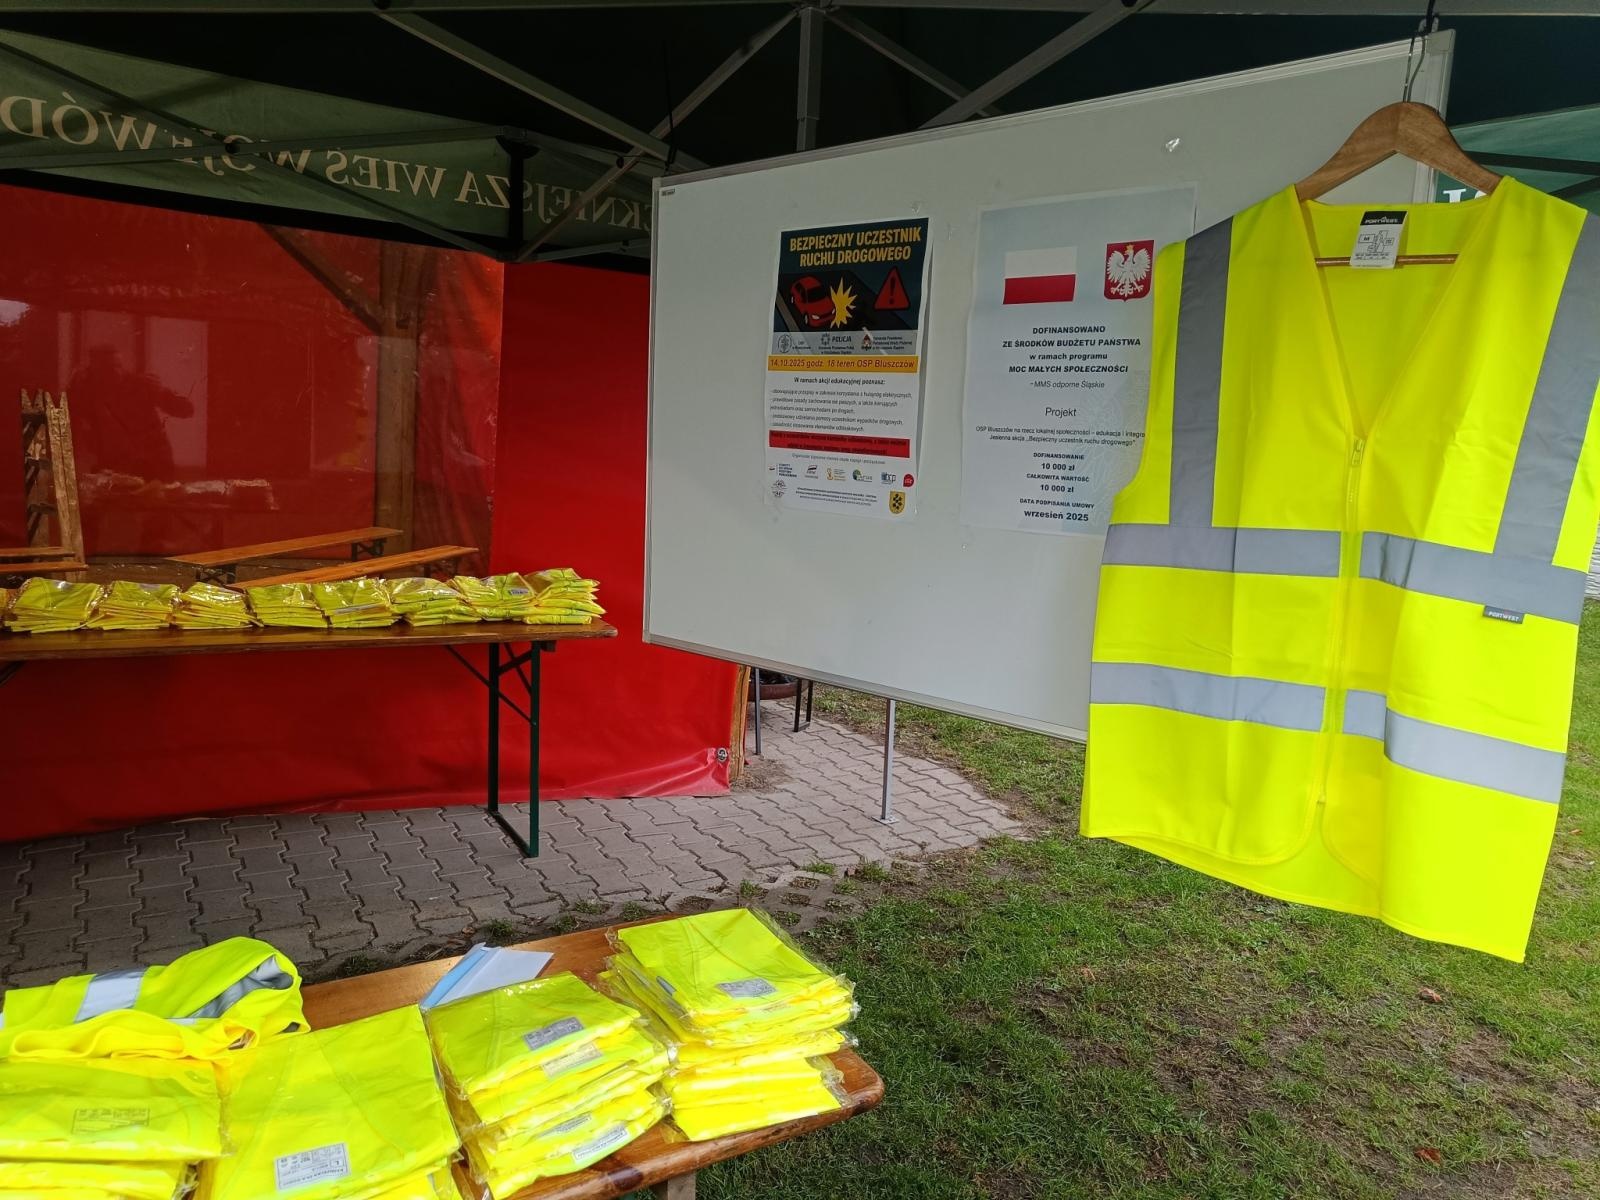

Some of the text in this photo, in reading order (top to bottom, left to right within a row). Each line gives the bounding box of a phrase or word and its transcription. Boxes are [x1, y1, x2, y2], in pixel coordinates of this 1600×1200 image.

[790, 226, 922, 252] BEZPIECZNY UCZESTNIK
[800, 246, 912, 267] RUCHU DROGOWEGO
[1032, 326, 1106, 334] DOFINANSOWANO
[1002, 337, 1141, 348] ZE ŚRODKÓW BUDŻETU PAŃSTWA
[1068, 353, 1108, 361] programu
[857, 359, 873, 368] OSP
[874, 359, 915, 369] Bluszczów
[1028, 365, 1062, 373] MAŁYCH
[1063, 365, 1129, 373] SPOŁECZNOŚCI
[1045, 407, 1077, 419] Projekt
[1033, 452, 1085, 460] DOFINANSOWANIE
[1041, 462, 1051, 470] 10
[1052, 463, 1067, 471] 000
[1026, 473, 1090, 483] CAŁKOWITA WARTOŚĆ
[1035, 499, 1071, 507] PODPISANIA
[1023, 510, 1089, 522] wrzesień 2025
